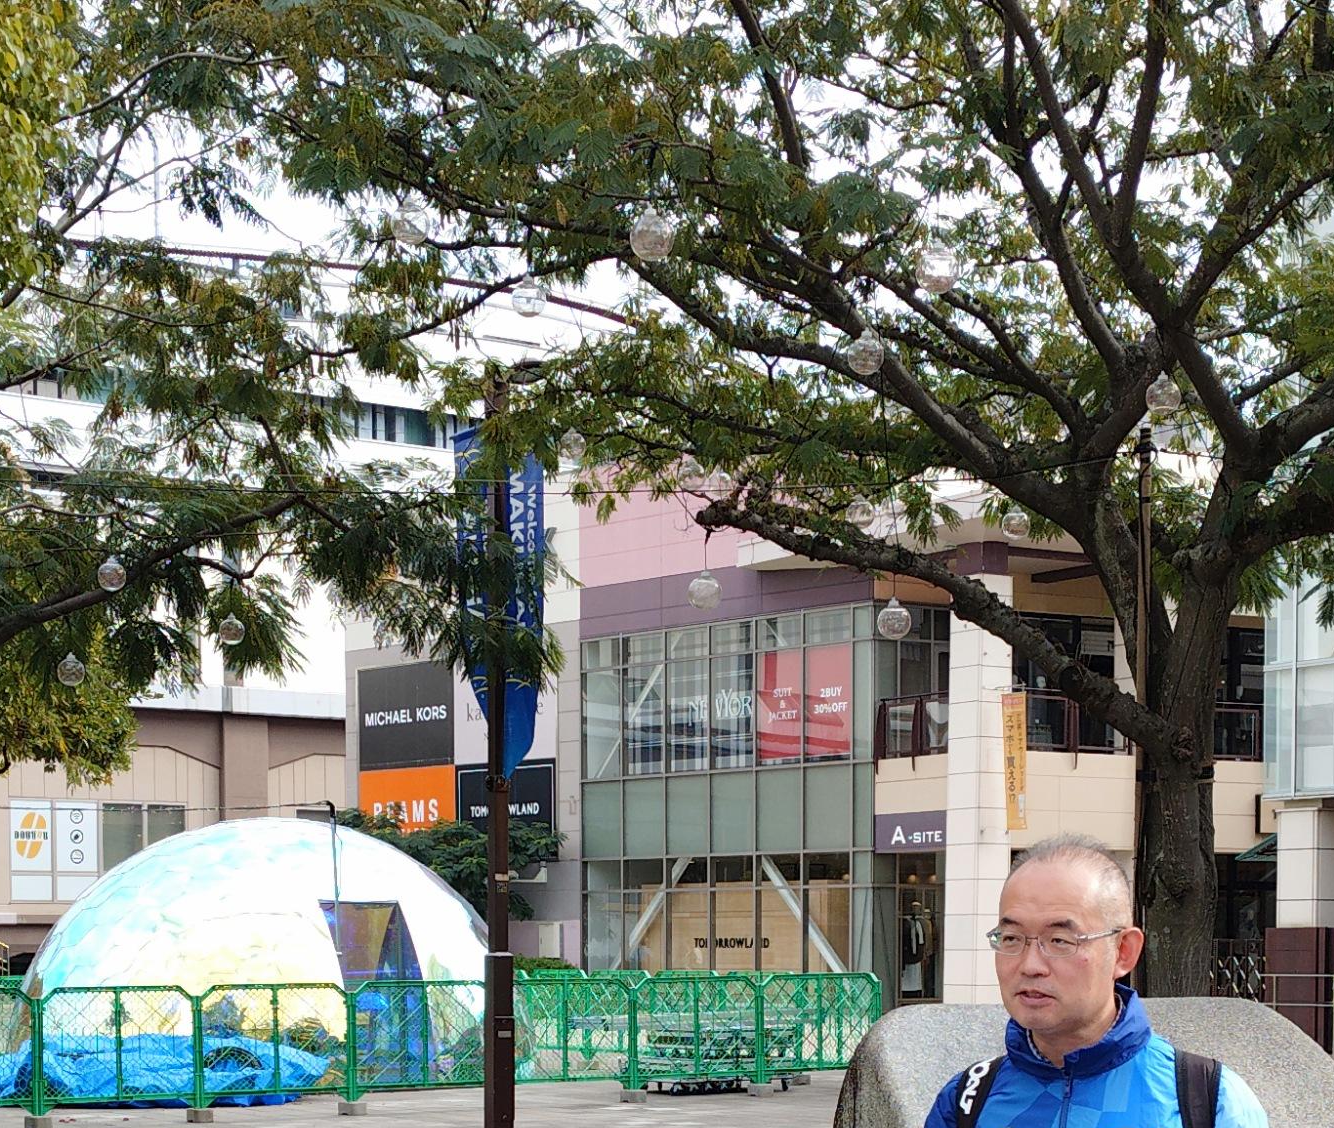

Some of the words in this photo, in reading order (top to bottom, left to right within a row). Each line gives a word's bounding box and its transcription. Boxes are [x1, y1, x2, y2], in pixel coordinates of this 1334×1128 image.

[820, 686, 843, 698] 2BUY
[814, 701, 849, 714] 30%OFF
[365, 708, 413, 727] MICHAEL
[416, 704, 447, 722] KORS
[768, 709, 798, 725] JACKET
[470, 802, 540, 817] TOMWLAND
